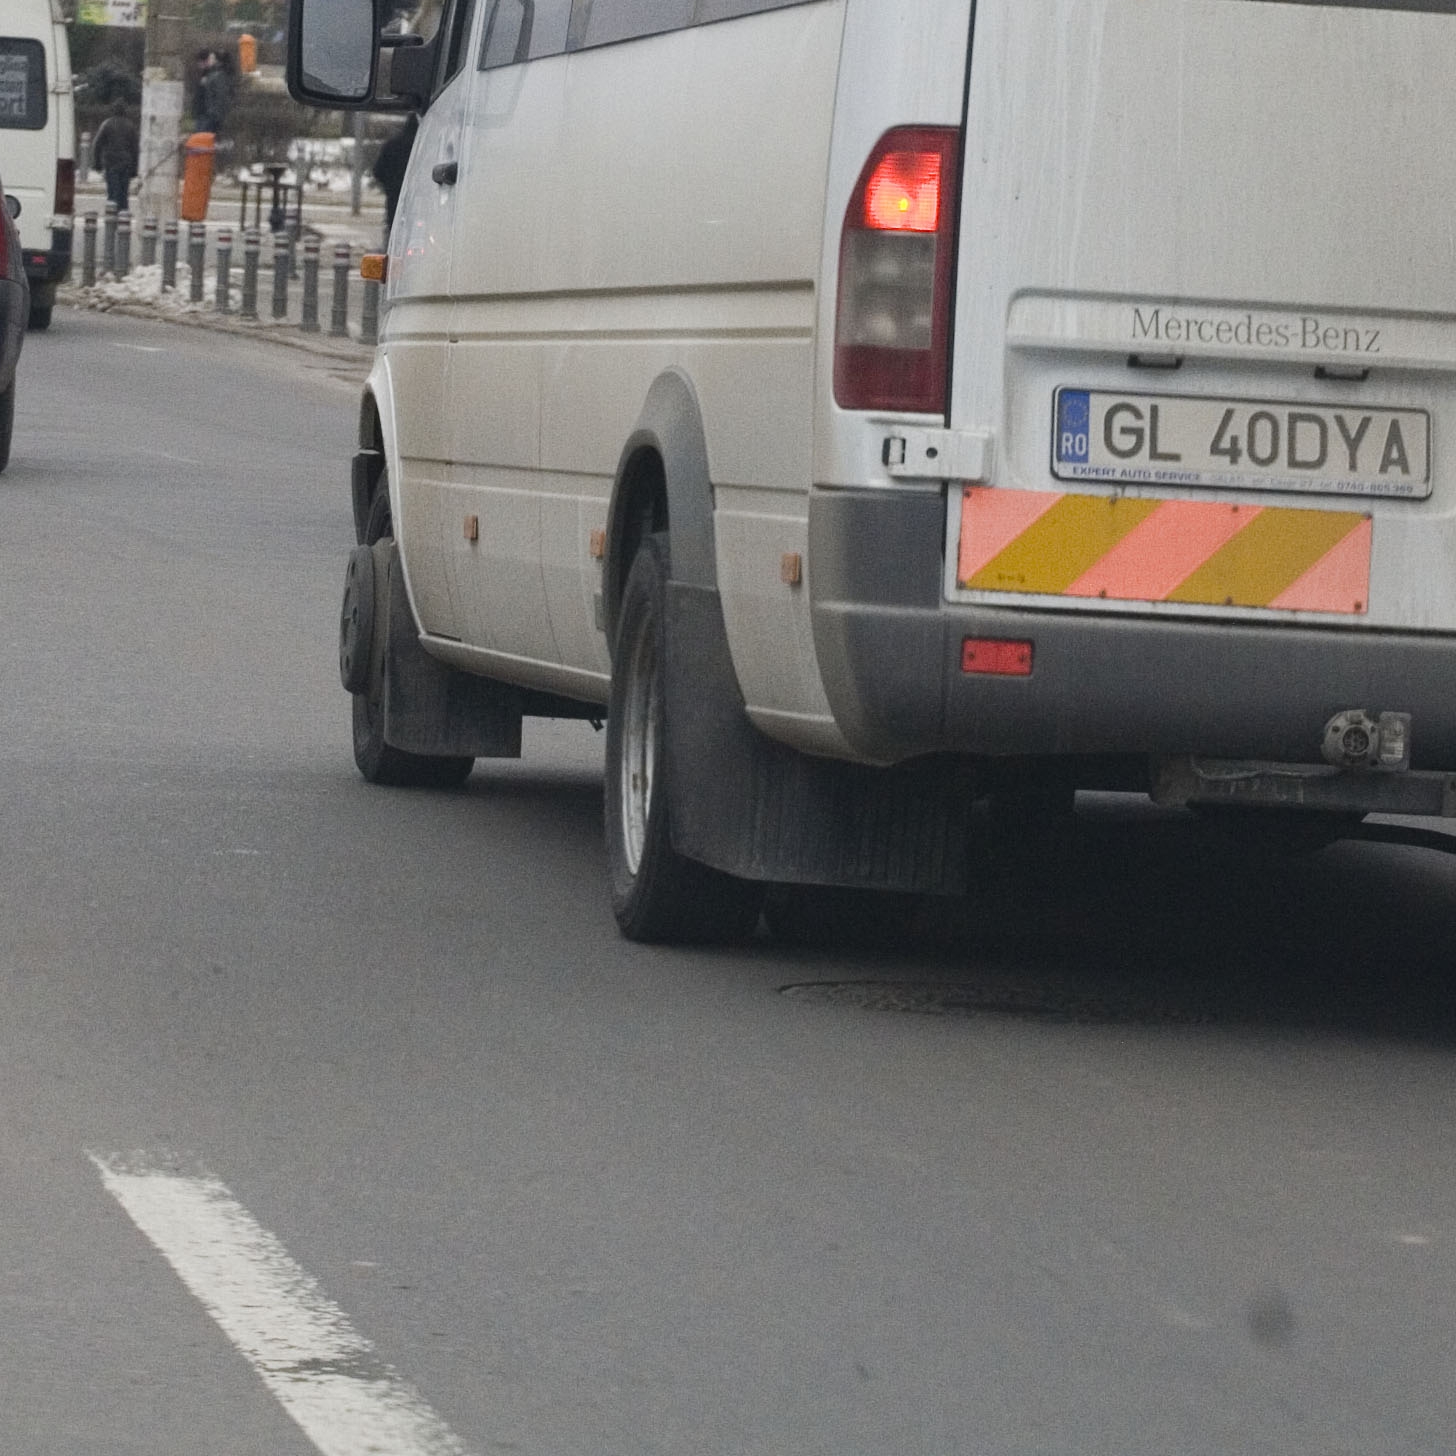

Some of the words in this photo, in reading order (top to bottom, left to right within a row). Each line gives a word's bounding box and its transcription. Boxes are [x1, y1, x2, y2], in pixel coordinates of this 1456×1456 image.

[1132, 307, 1381, 353] Mercedes-Benz
[1061, 432, 1087, 458] RO
[1103, 402, 1182, 462] GL
[1209, 407, 1411, 475] 40DYA
[1072, 466, 1116, 477] EXPERT
[1120, 468, 1151, 479] AUTO
[1155, 470, 1200, 482] SERVICE
